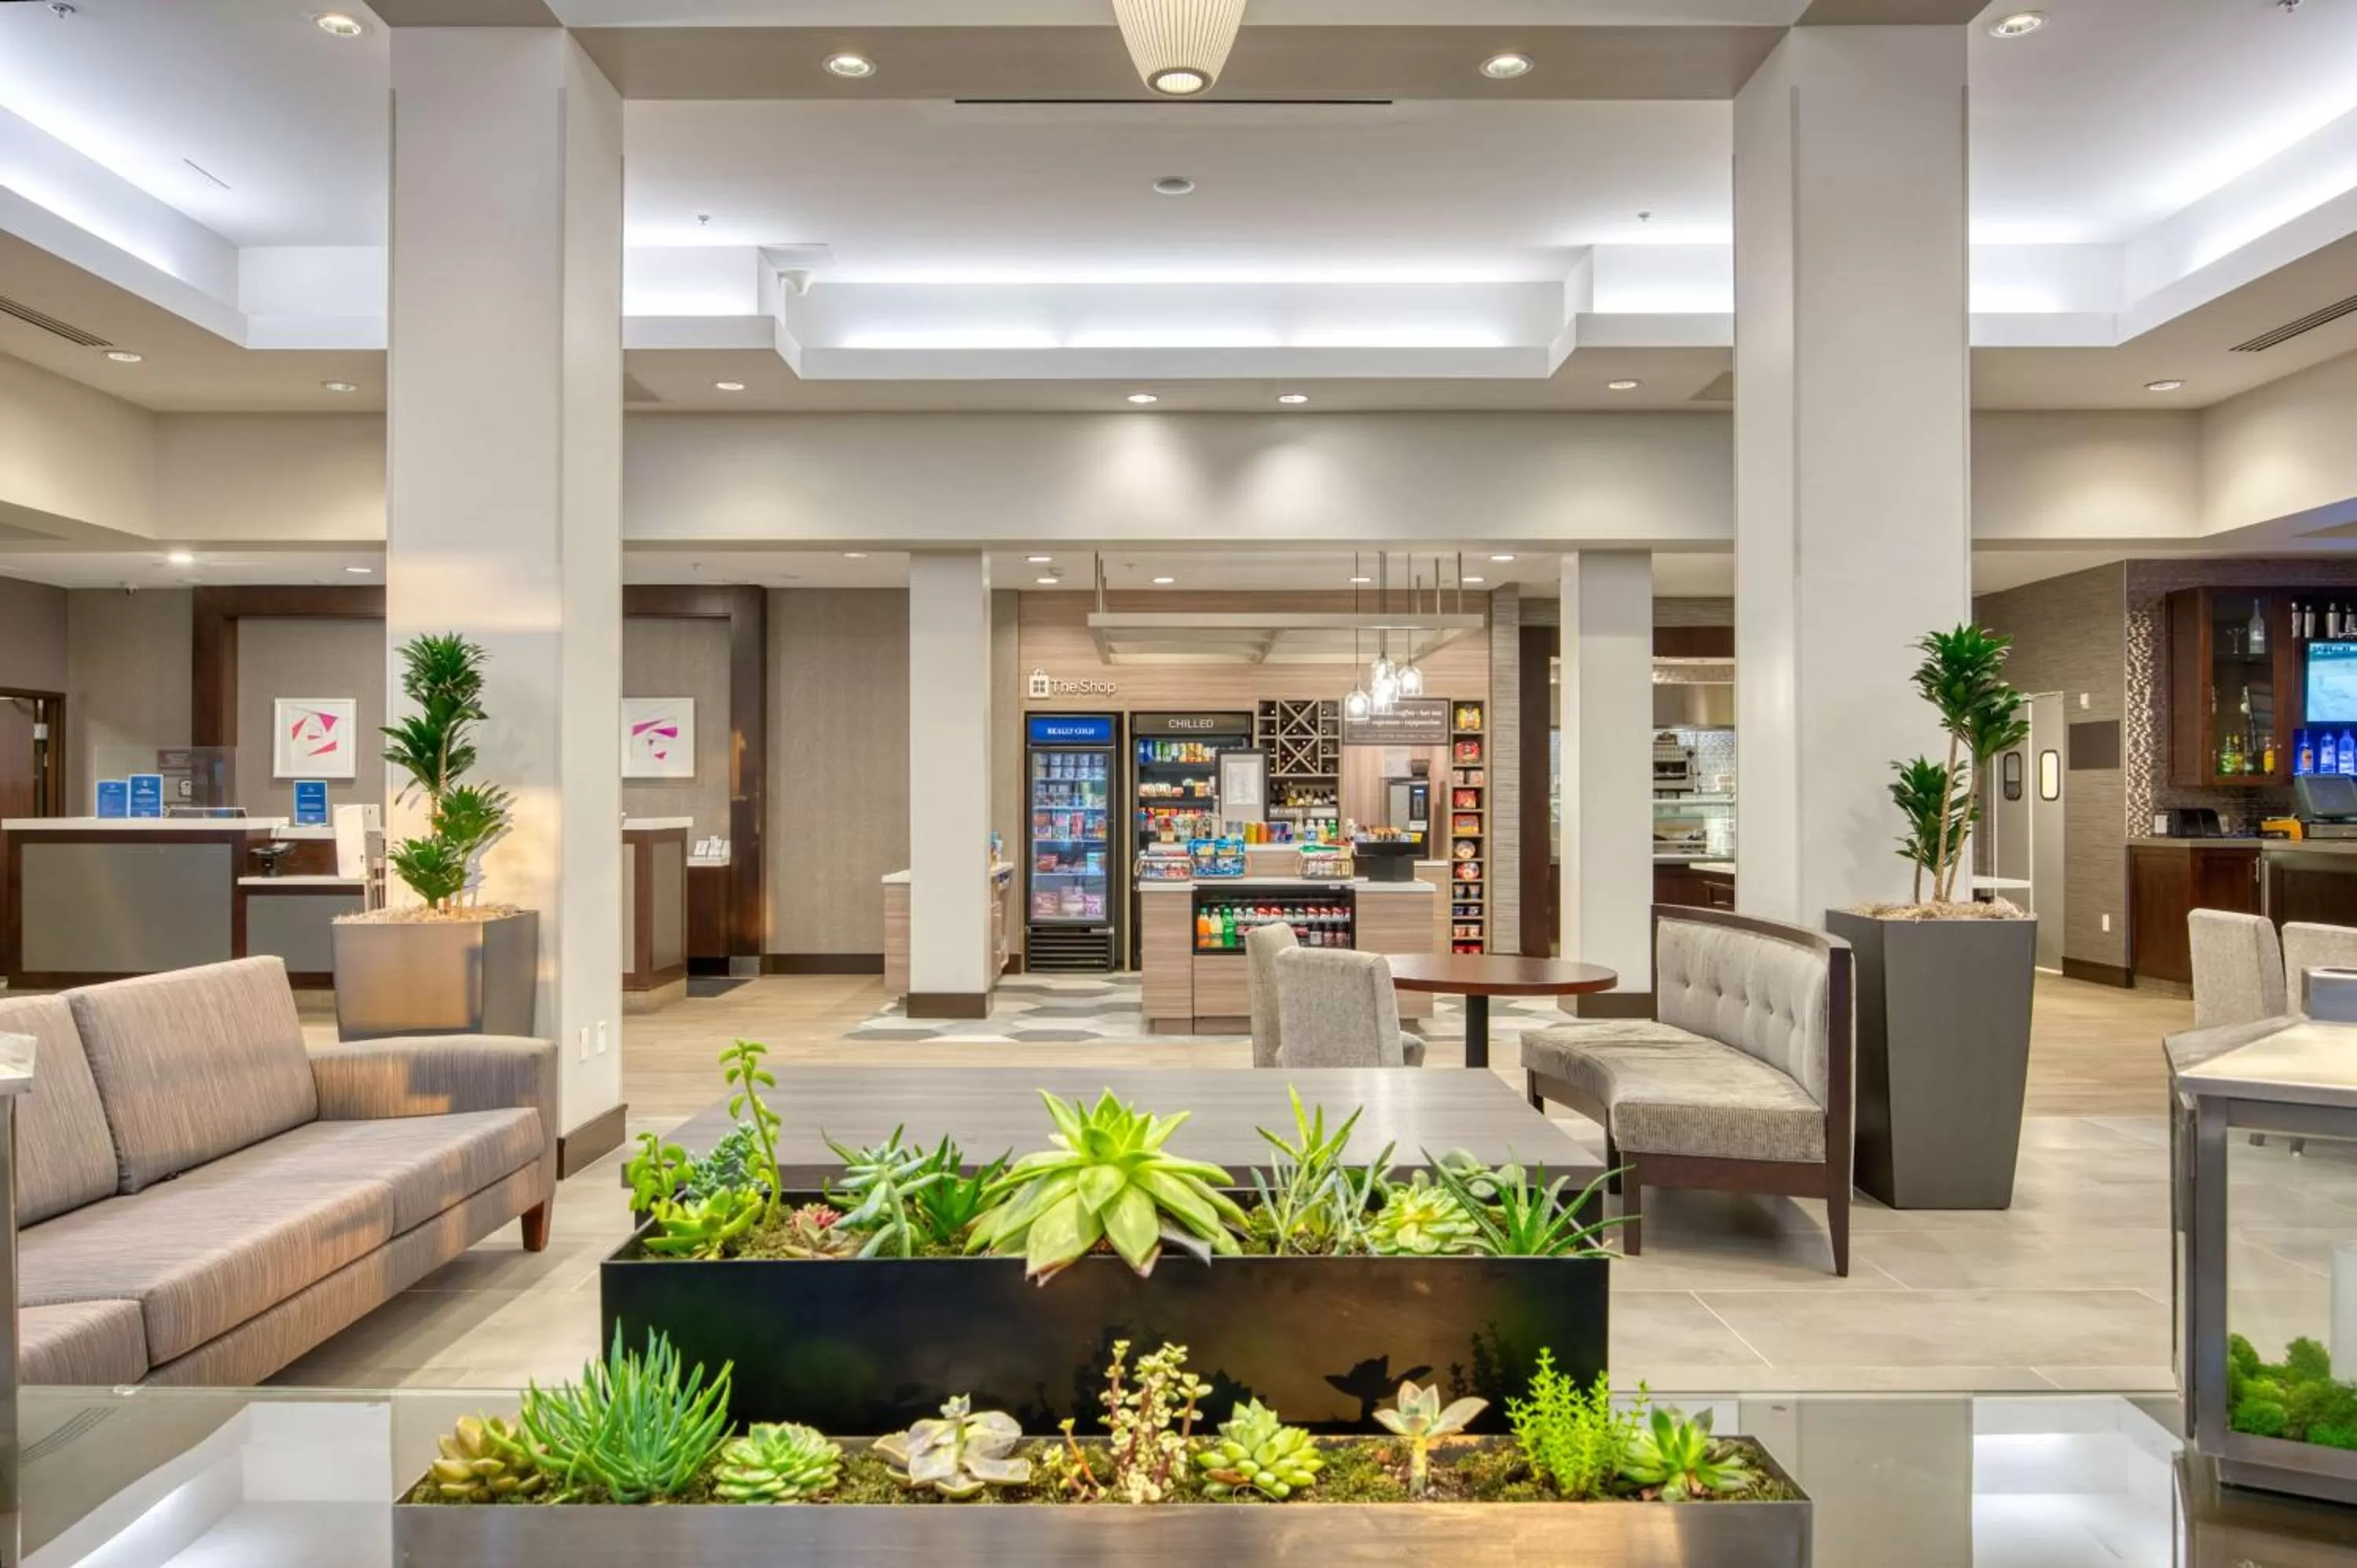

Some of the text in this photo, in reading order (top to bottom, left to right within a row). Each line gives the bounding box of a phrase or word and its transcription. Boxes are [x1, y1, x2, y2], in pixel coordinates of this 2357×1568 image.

[1050, 679, 1116, 695] The Shop
[1168, 719, 1214, 728] CHILLED
